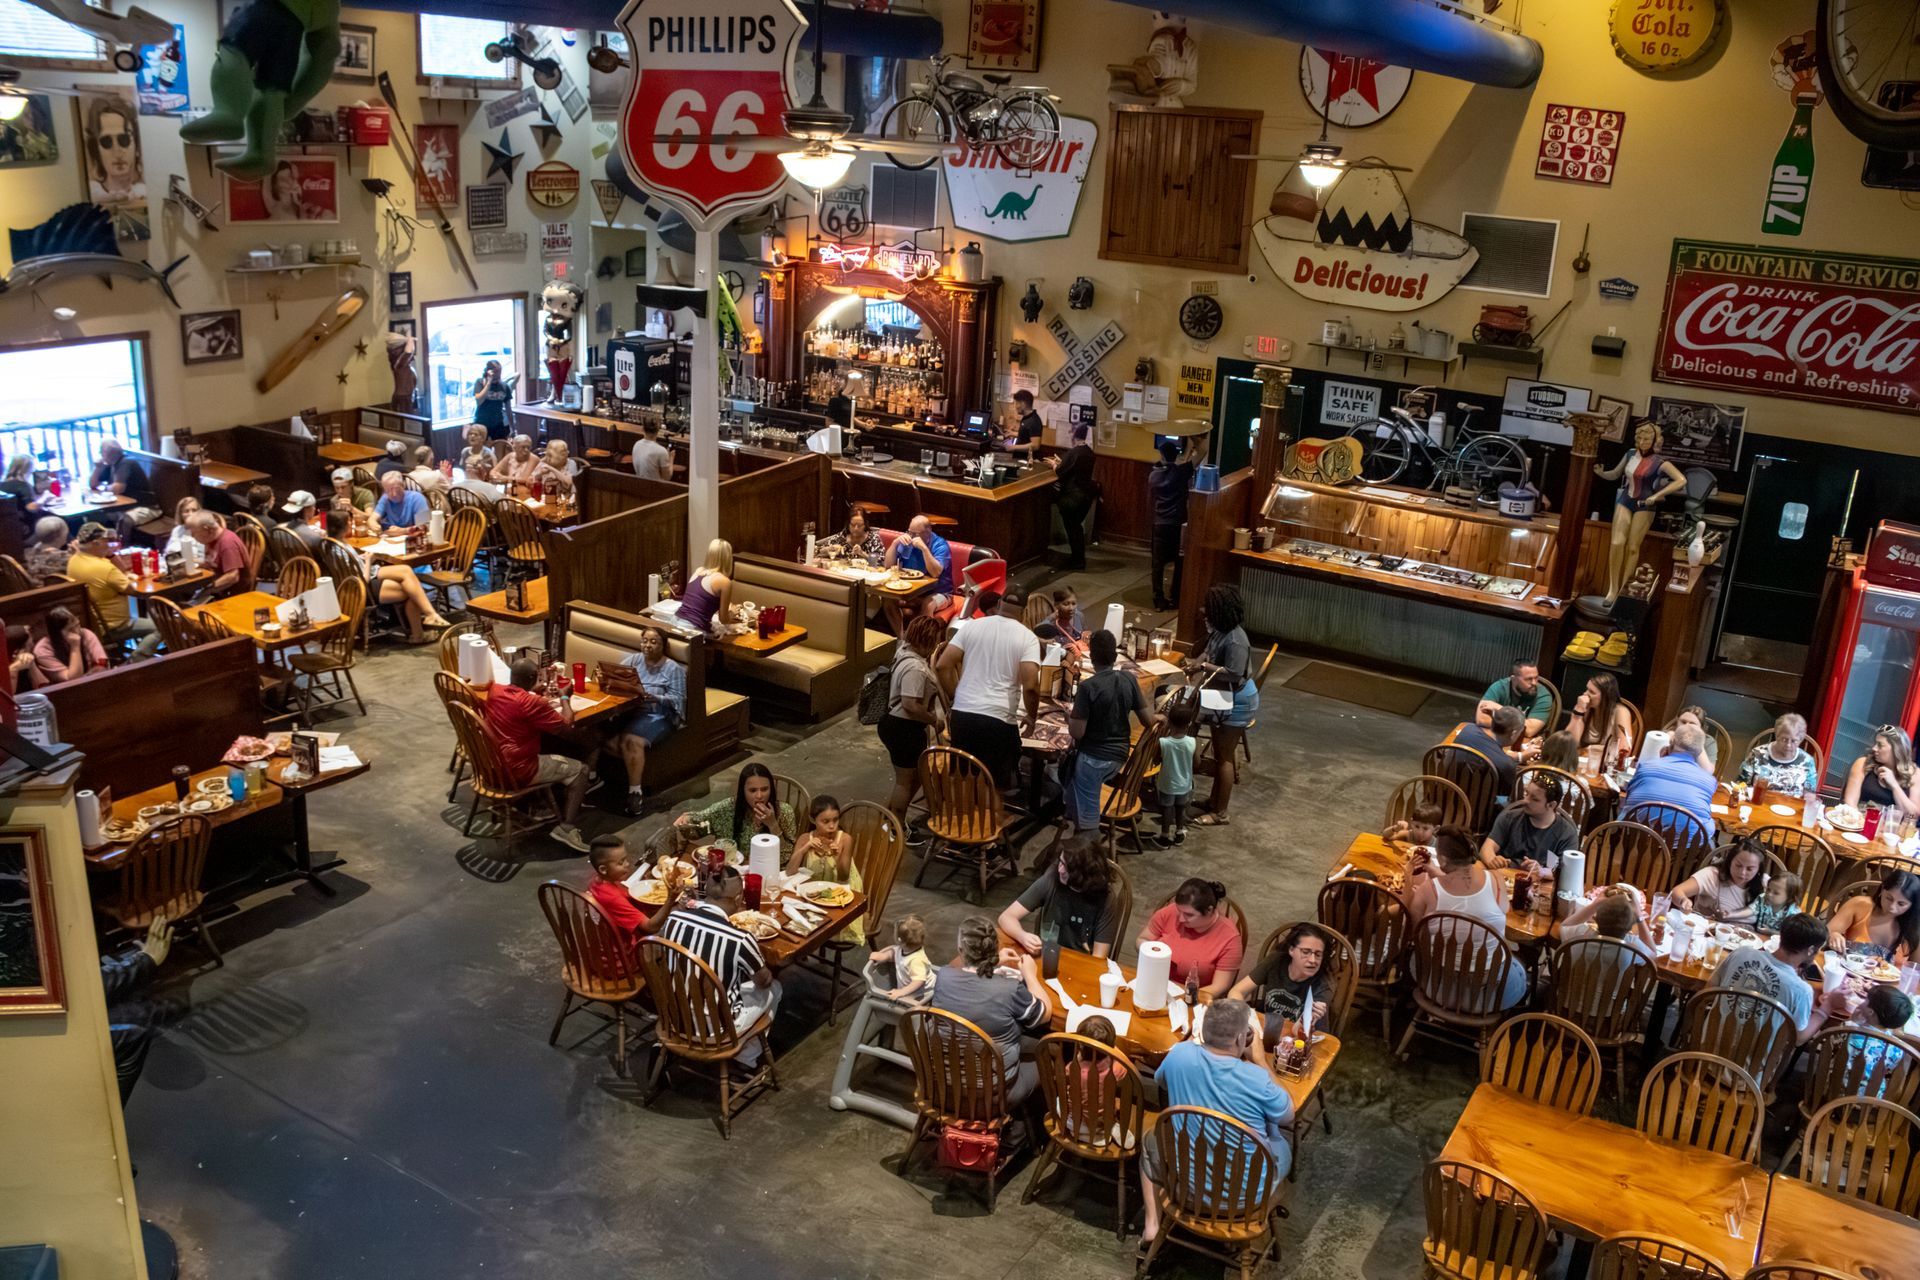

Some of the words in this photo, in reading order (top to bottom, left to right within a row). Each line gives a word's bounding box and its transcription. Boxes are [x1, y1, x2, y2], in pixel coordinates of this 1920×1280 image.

[649, 15, 776, 54] PHILLIPS
[1632, 13, 1691, 38] Cola
[1641, 41, 1656, 55] 16
[1661, 43, 1681, 57] Oz.
[982, 55, 988, 65] 7
[652, 88, 766, 173] 66
[1765, 164, 1809, 224] 7UP
[827, 206, 860, 233] 66
[546, 224, 568, 235] VALET
[543, 236, 572, 248] PARKING
[882, 251, 931, 270] BOULEVARD
[1293, 256, 1429, 301] Delicious!
[1696, 251, 1815, 280] FOUNTAIN
[1822, 263, 1920, 295] SERVIC
[1743, 285, 1820, 304] DRINK
[1674, 283, 1920, 374] Coca-Cola
[1257, 336, 1278, 353] EXIT
[617, 359, 634, 374] Lite
[1048, 328, 1116, 394] CROSSING
[1050, 319, 1078, 358] RAIL
[1086, 367, 1117, 405] ROAD
[1181, 365, 1212, 383] DANGER
[1671, 354, 1757, 379] Delicious
[1763, 368, 1797, 384] and
[1804, 371, 1911, 404] Refreshing
[1187, 382, 1203, 394] MEN
[1331, 386, 1374, 402] THINK
[1178, 393, 1210, 408] WORKING
[1332, 399, 1369, 413] SAFE
[1326, 410, 1346, 421] WORK
[1763, 965, 1781, 998] WATER
